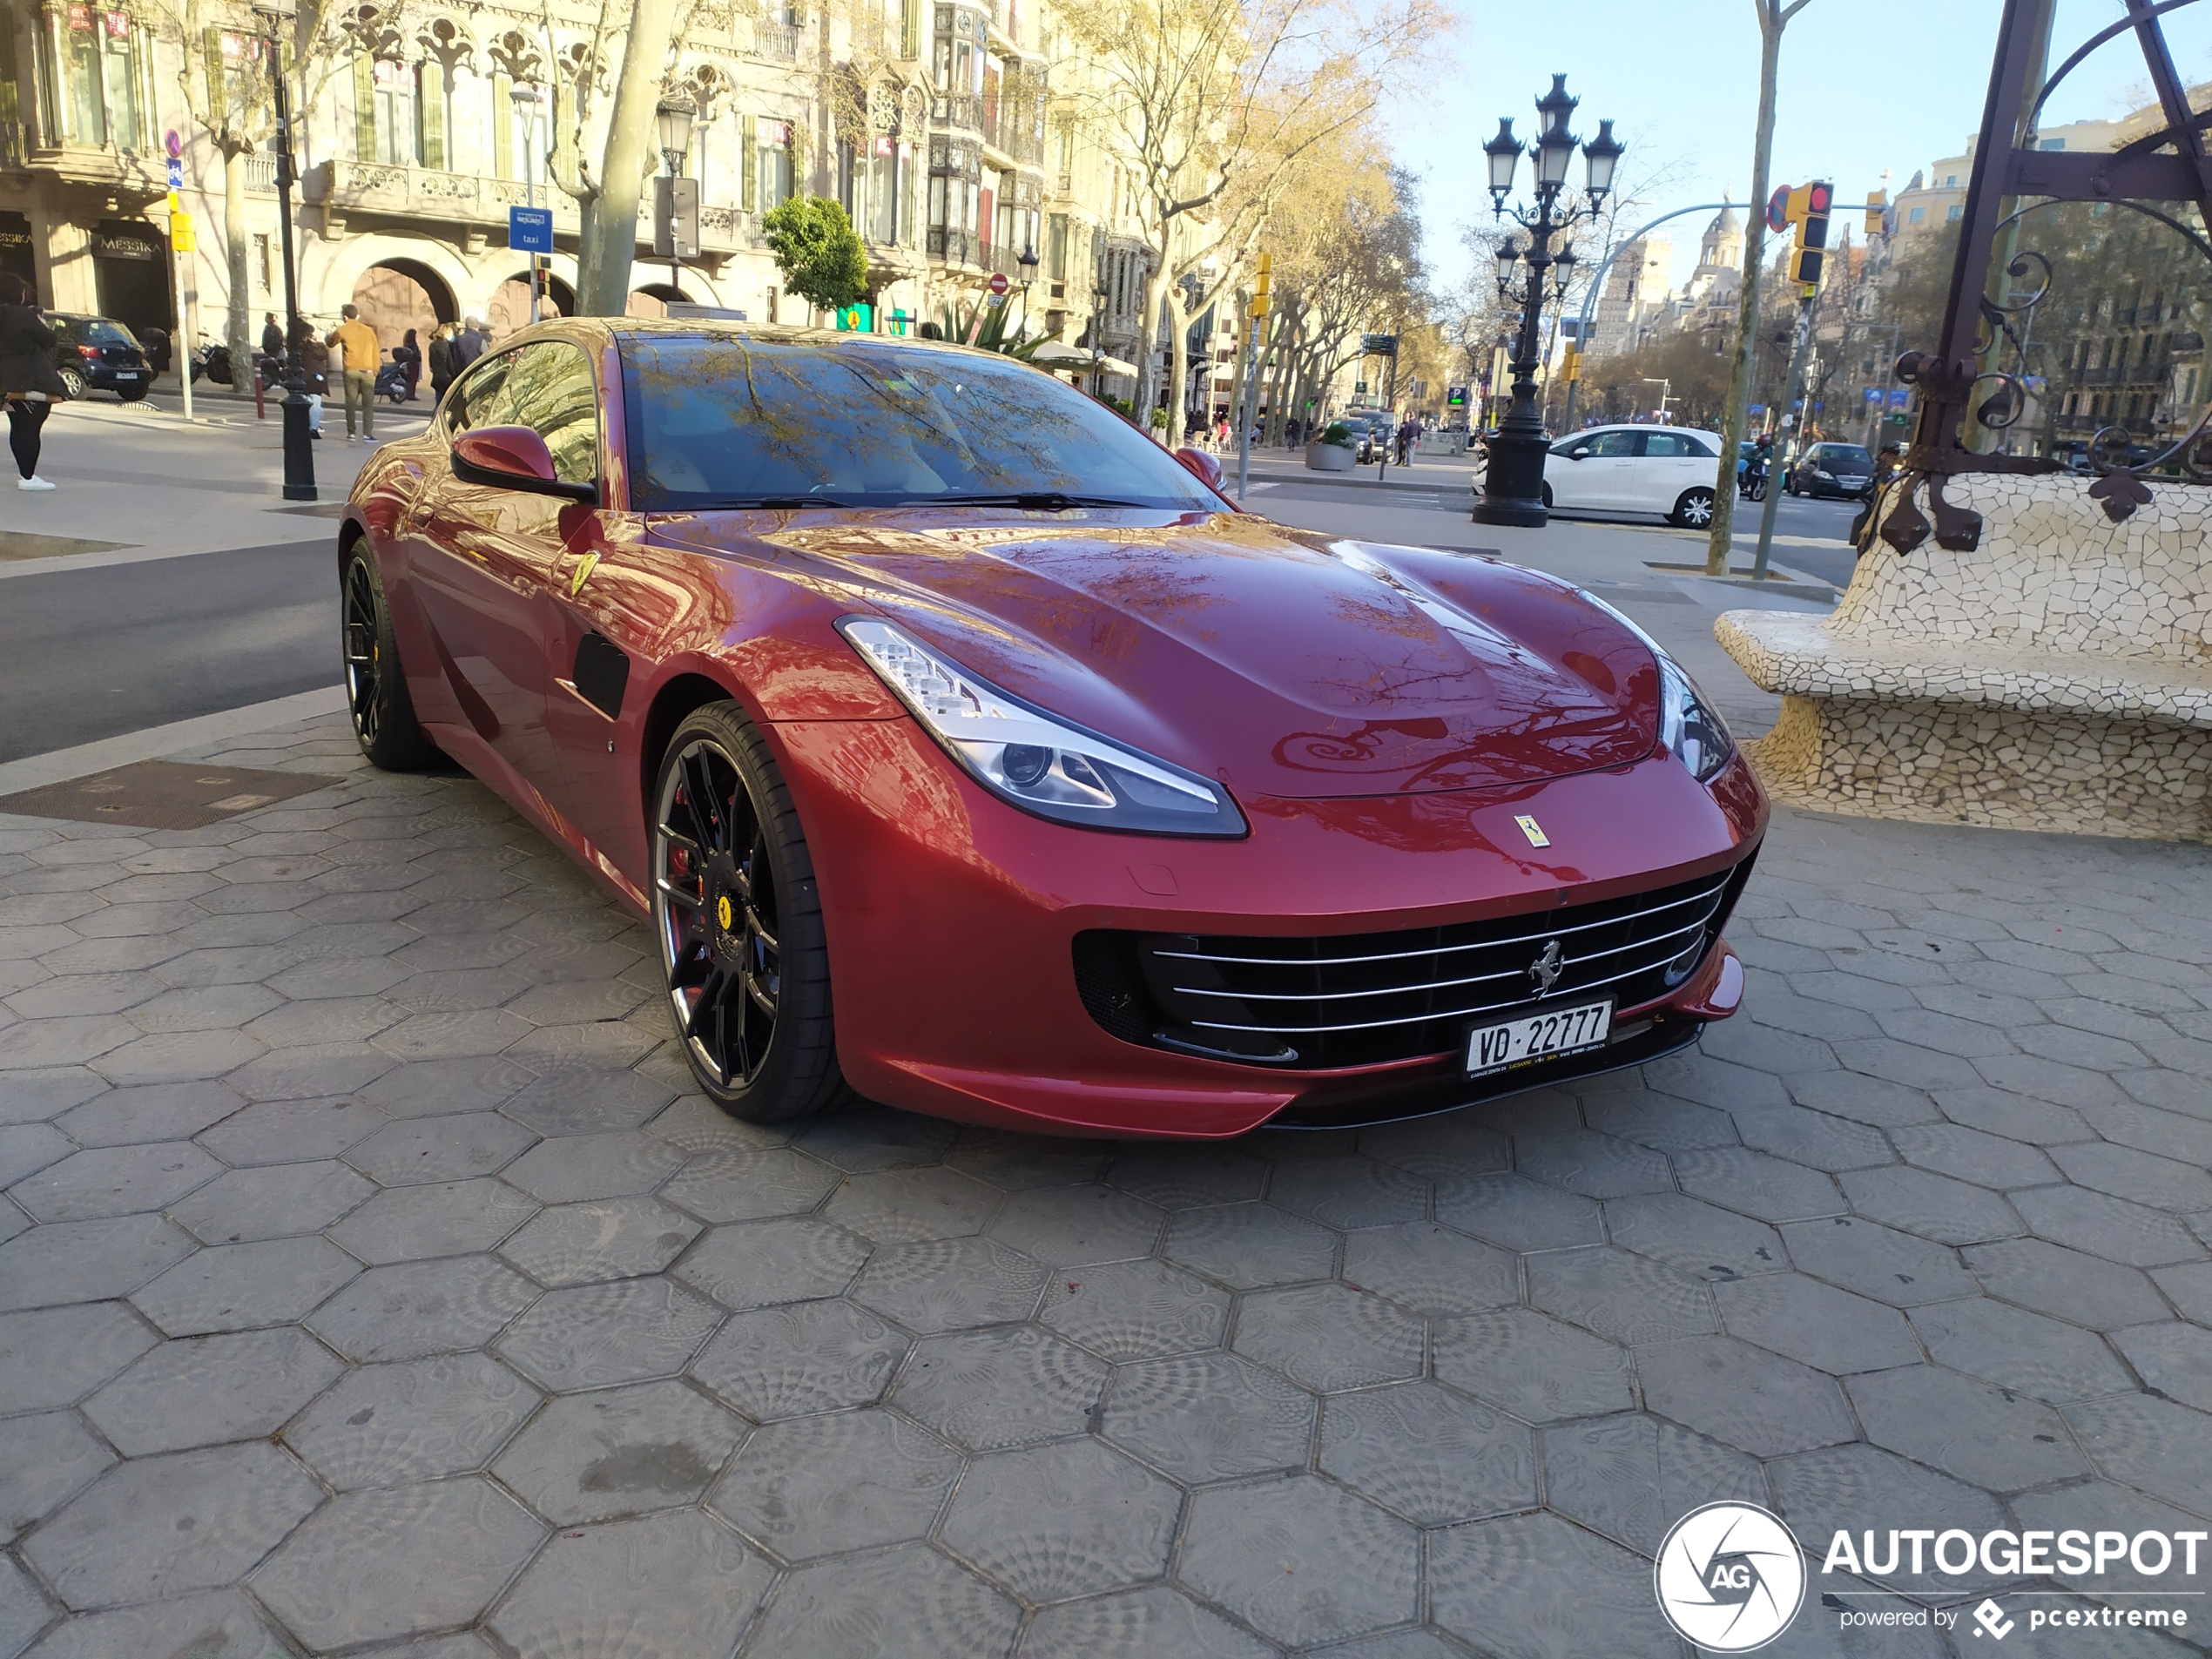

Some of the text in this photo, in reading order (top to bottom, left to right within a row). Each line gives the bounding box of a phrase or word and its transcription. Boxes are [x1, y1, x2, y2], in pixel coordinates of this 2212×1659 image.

[100, 237, 162, 253] MESSIKA
[523, 234, 538, 244] taxi
[1453, 388, 1461, 398] P
[1481, 1006, 1604, 1066] VD 22777
